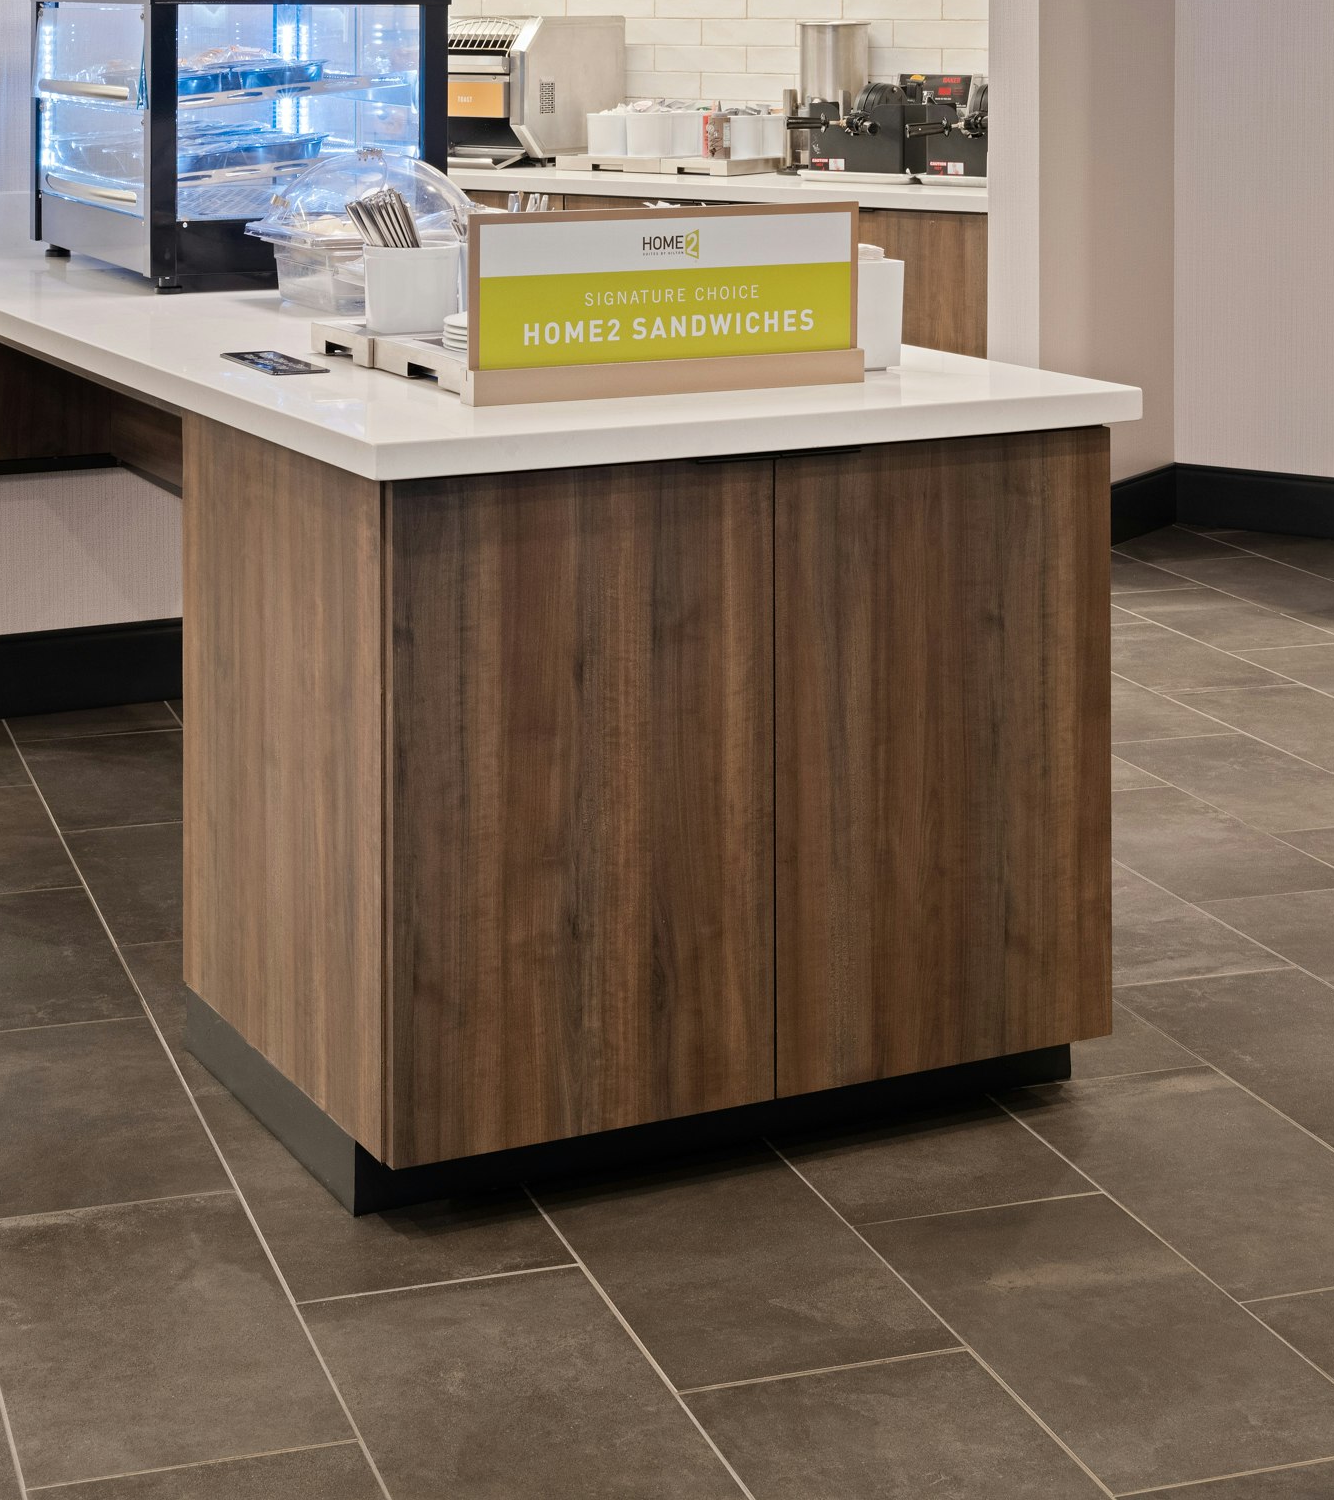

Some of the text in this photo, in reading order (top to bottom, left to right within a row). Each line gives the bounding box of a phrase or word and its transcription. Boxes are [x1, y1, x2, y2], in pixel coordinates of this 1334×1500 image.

[584, 284, 761, 308] SIGNATURE CHOICE
[523, 308, 815, 346] HOME2 SANDWICHES
